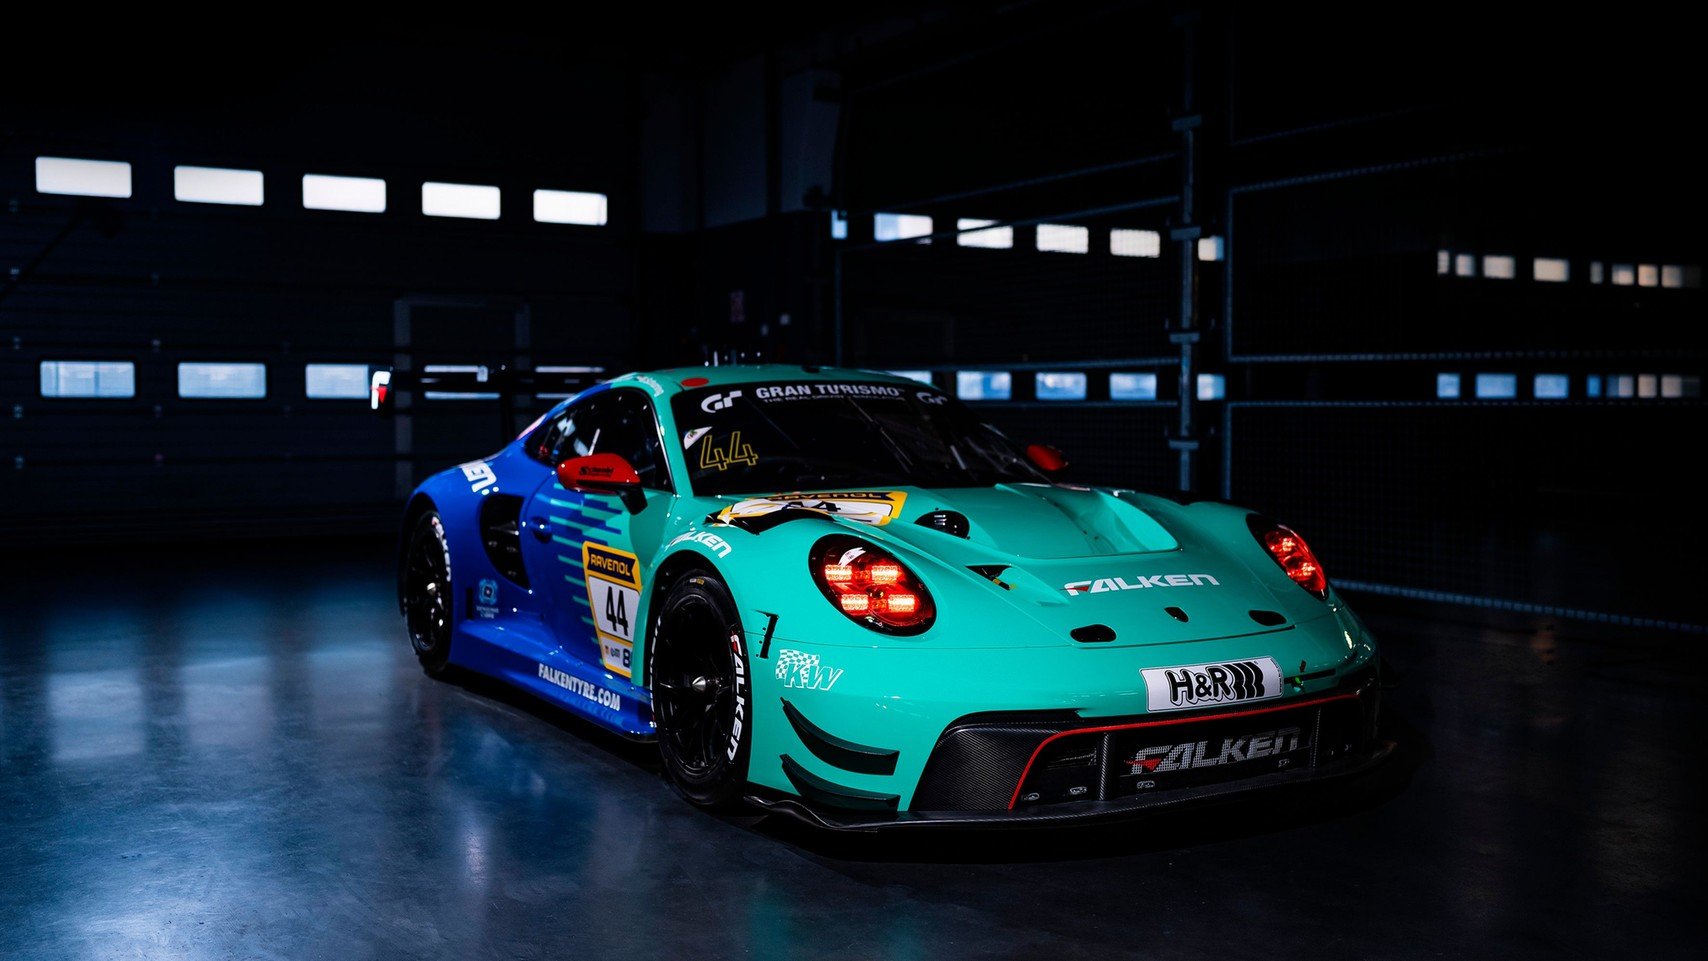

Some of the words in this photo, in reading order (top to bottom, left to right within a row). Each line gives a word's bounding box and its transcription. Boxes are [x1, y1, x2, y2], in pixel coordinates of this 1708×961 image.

[756, 385, 811, 400] GRAN
[815, 384, 901, 397] TURISMO
[700, 430, 759, 471] 44
[590, 554, 631, 576] RAVENOL
[1062, 573, 1221, 596] FALKEN
[606, 586, 629, 637] 44
[538, 663, 621, 711] FALKENTYRE.COM
[784, 661, 844, 691] KW
[1165, 666, 1235, 705] H&R
[727, 632, 745, 762] FALKEN
[1127, 727, 1301, 775] FALKEN
